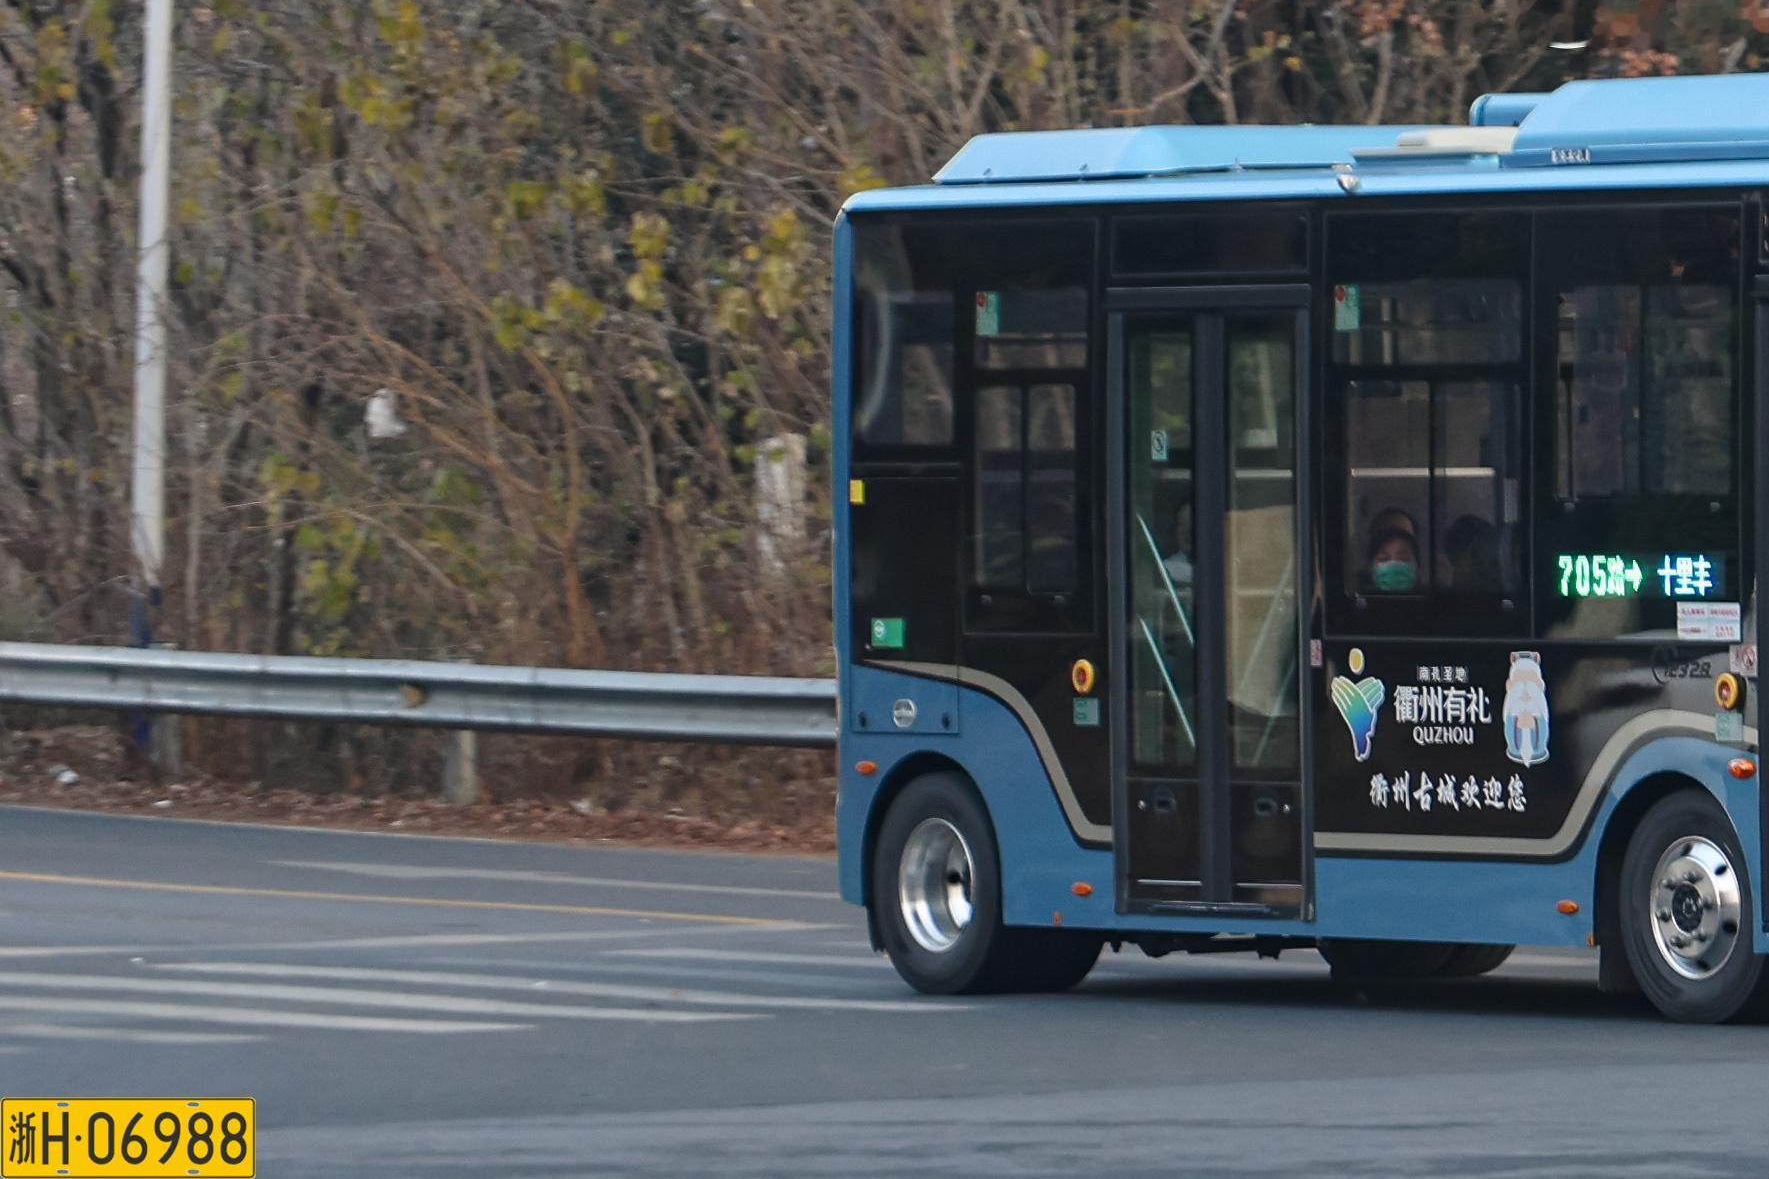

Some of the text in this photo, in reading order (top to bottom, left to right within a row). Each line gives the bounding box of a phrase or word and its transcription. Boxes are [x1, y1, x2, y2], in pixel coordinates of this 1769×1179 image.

[1558, 554, 1713, 597] 705路 十里丰
[1418, 666, 1468, 682] 南孔圣地
[1393, 685, 1492, 724] 衢州有礼
[1413, 726, 1474, 745] QUZHOU
[1369, 770, 1527, 812] 衢州古城欢迎您
